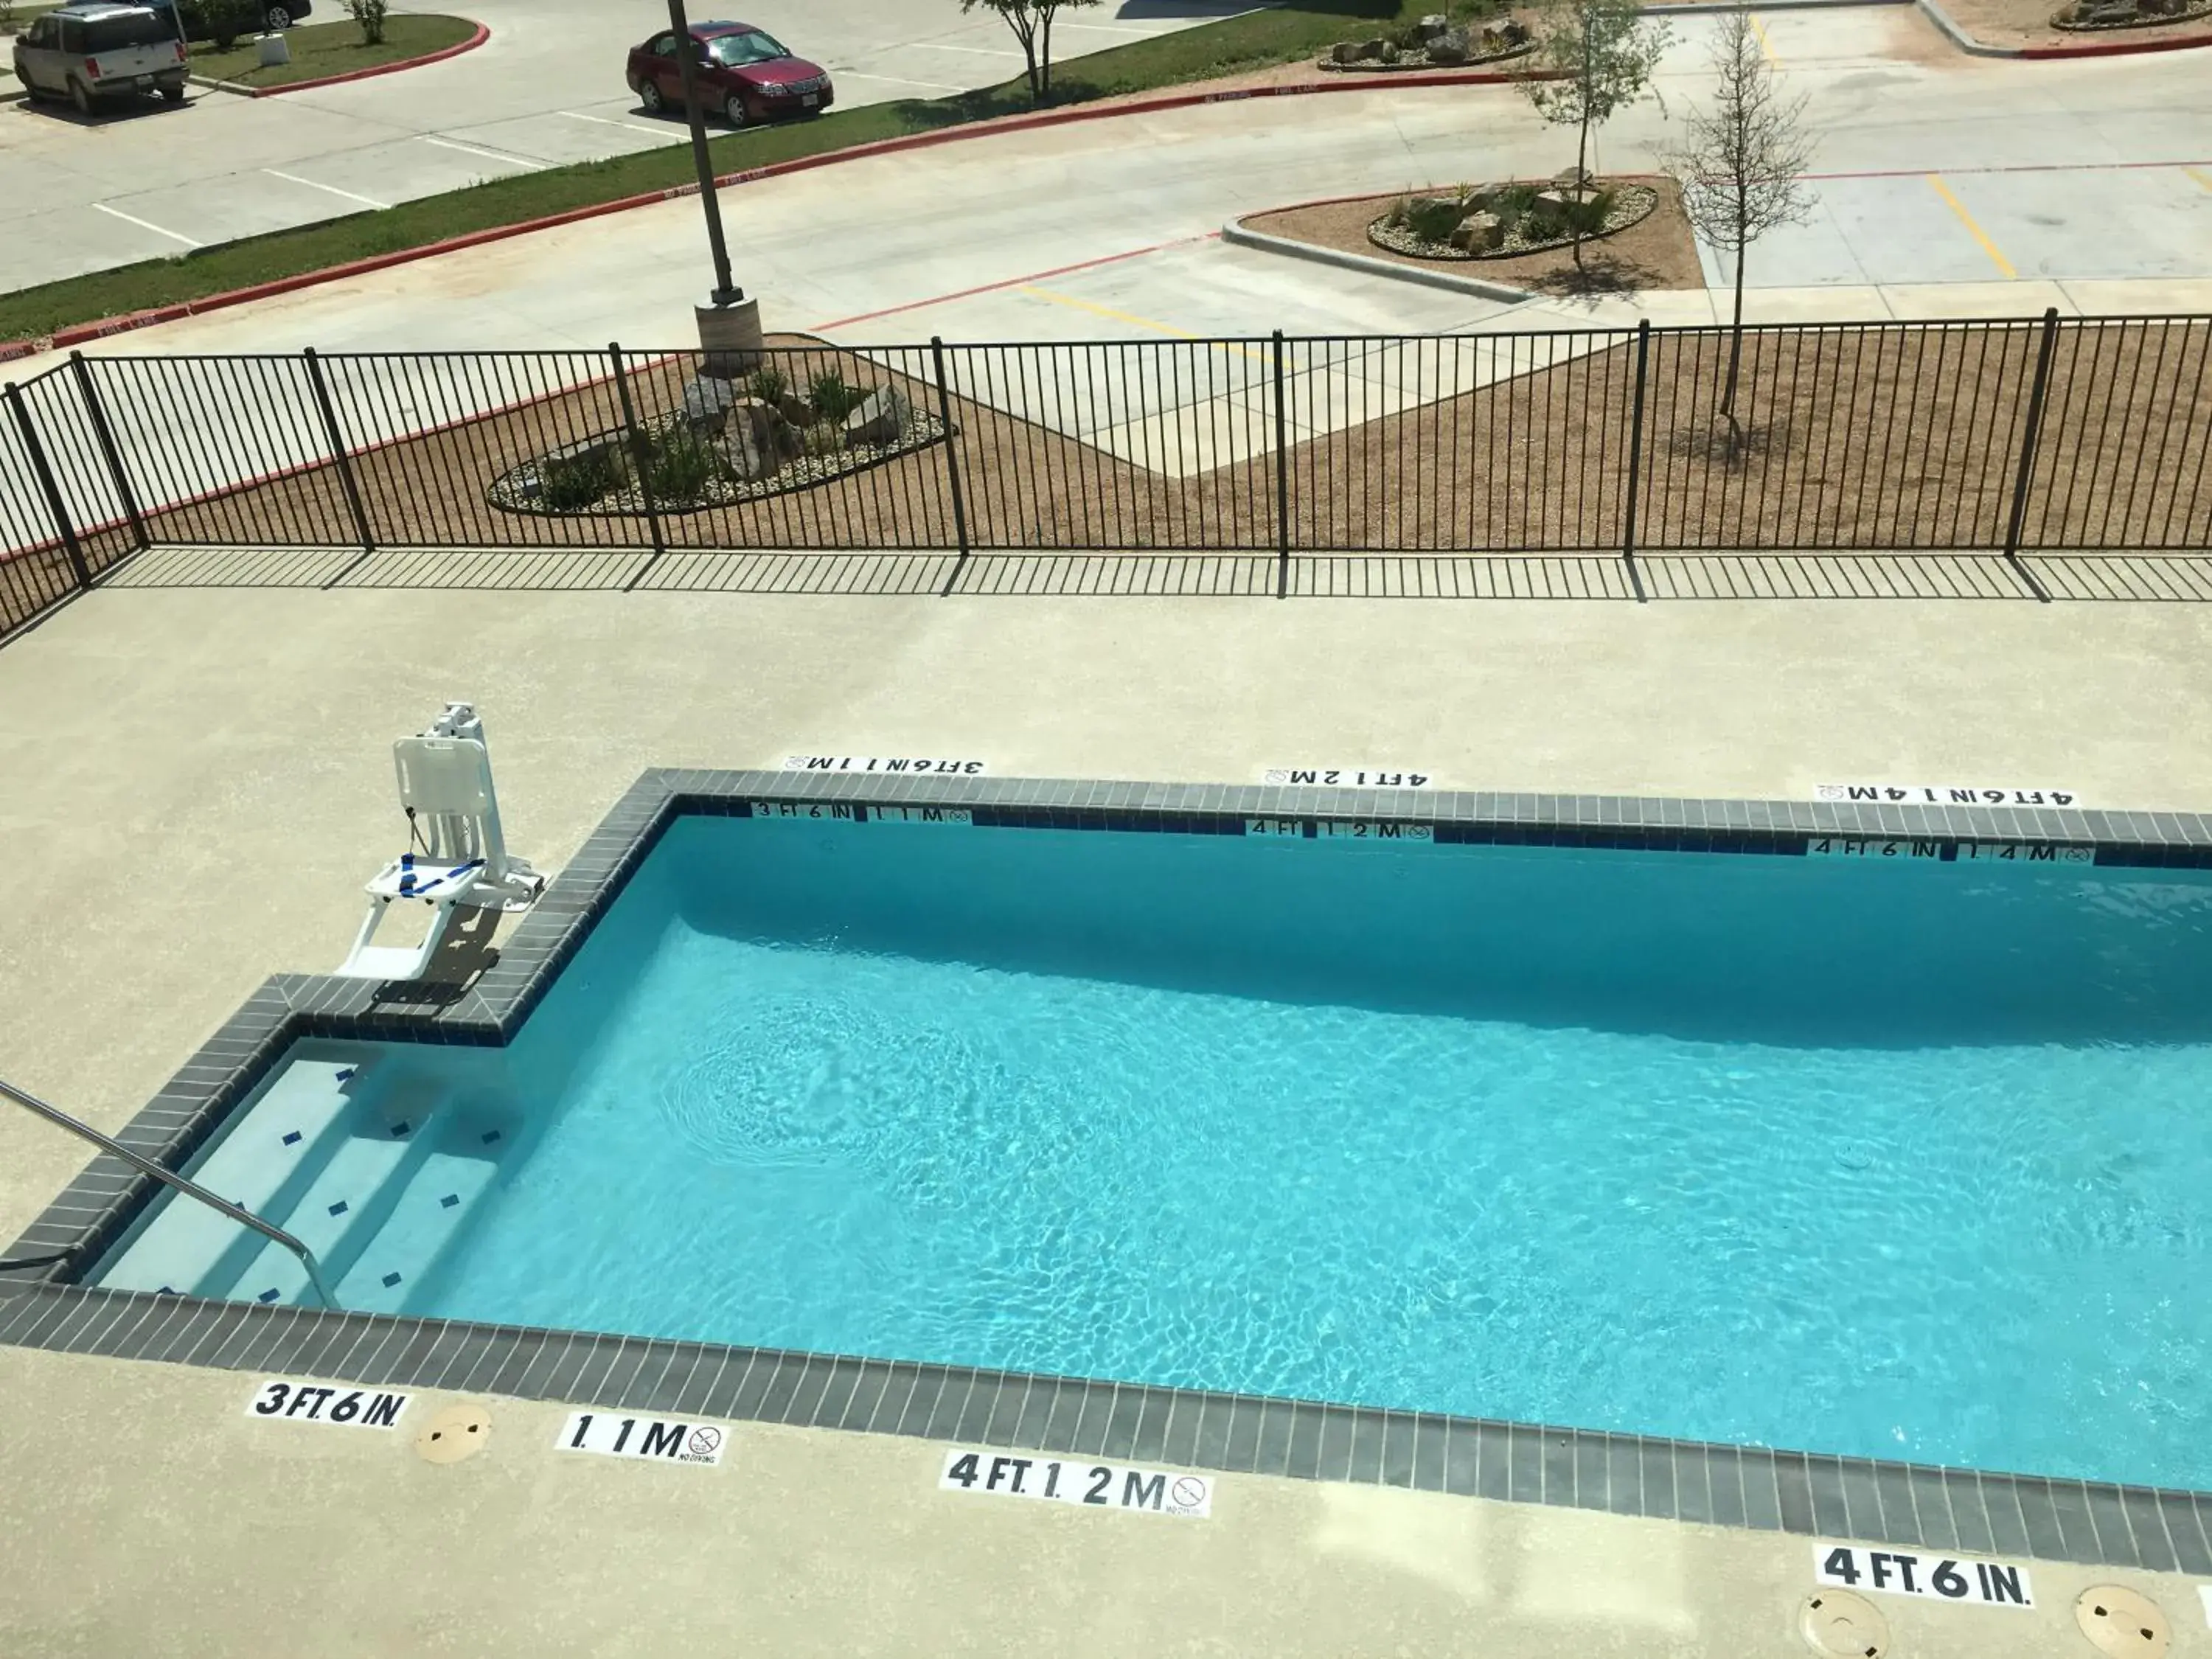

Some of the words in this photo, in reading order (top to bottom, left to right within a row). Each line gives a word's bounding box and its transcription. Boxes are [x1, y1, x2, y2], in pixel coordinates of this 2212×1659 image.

[914, 759, 932, 772] 6
[964, 762, 984, 773] 3
[1408, 774, 1427, 786] 4
[1983, 790, 2005, 803] 6
[2050, 791, 2073, 805] 4
[758, 803, 771, 816] 3
[809, 805, 821, 818] 6
[1252, 819, 1267, 832] 4
[1815, 839, 1830, 854] 4
[1882, 842, 1897, 856] 6
[256, 1383, 291, 1415] 3
[330, 1391, 366, 1422] 6
[640, 1422, 688, 1458] M
[948, 1454, 980, 1487] 4
[1121, 1471, 1166, 1511] M
[1824, 1548, 1862, 1585] 4
[1932, 1559, 1969, 1599] 6
